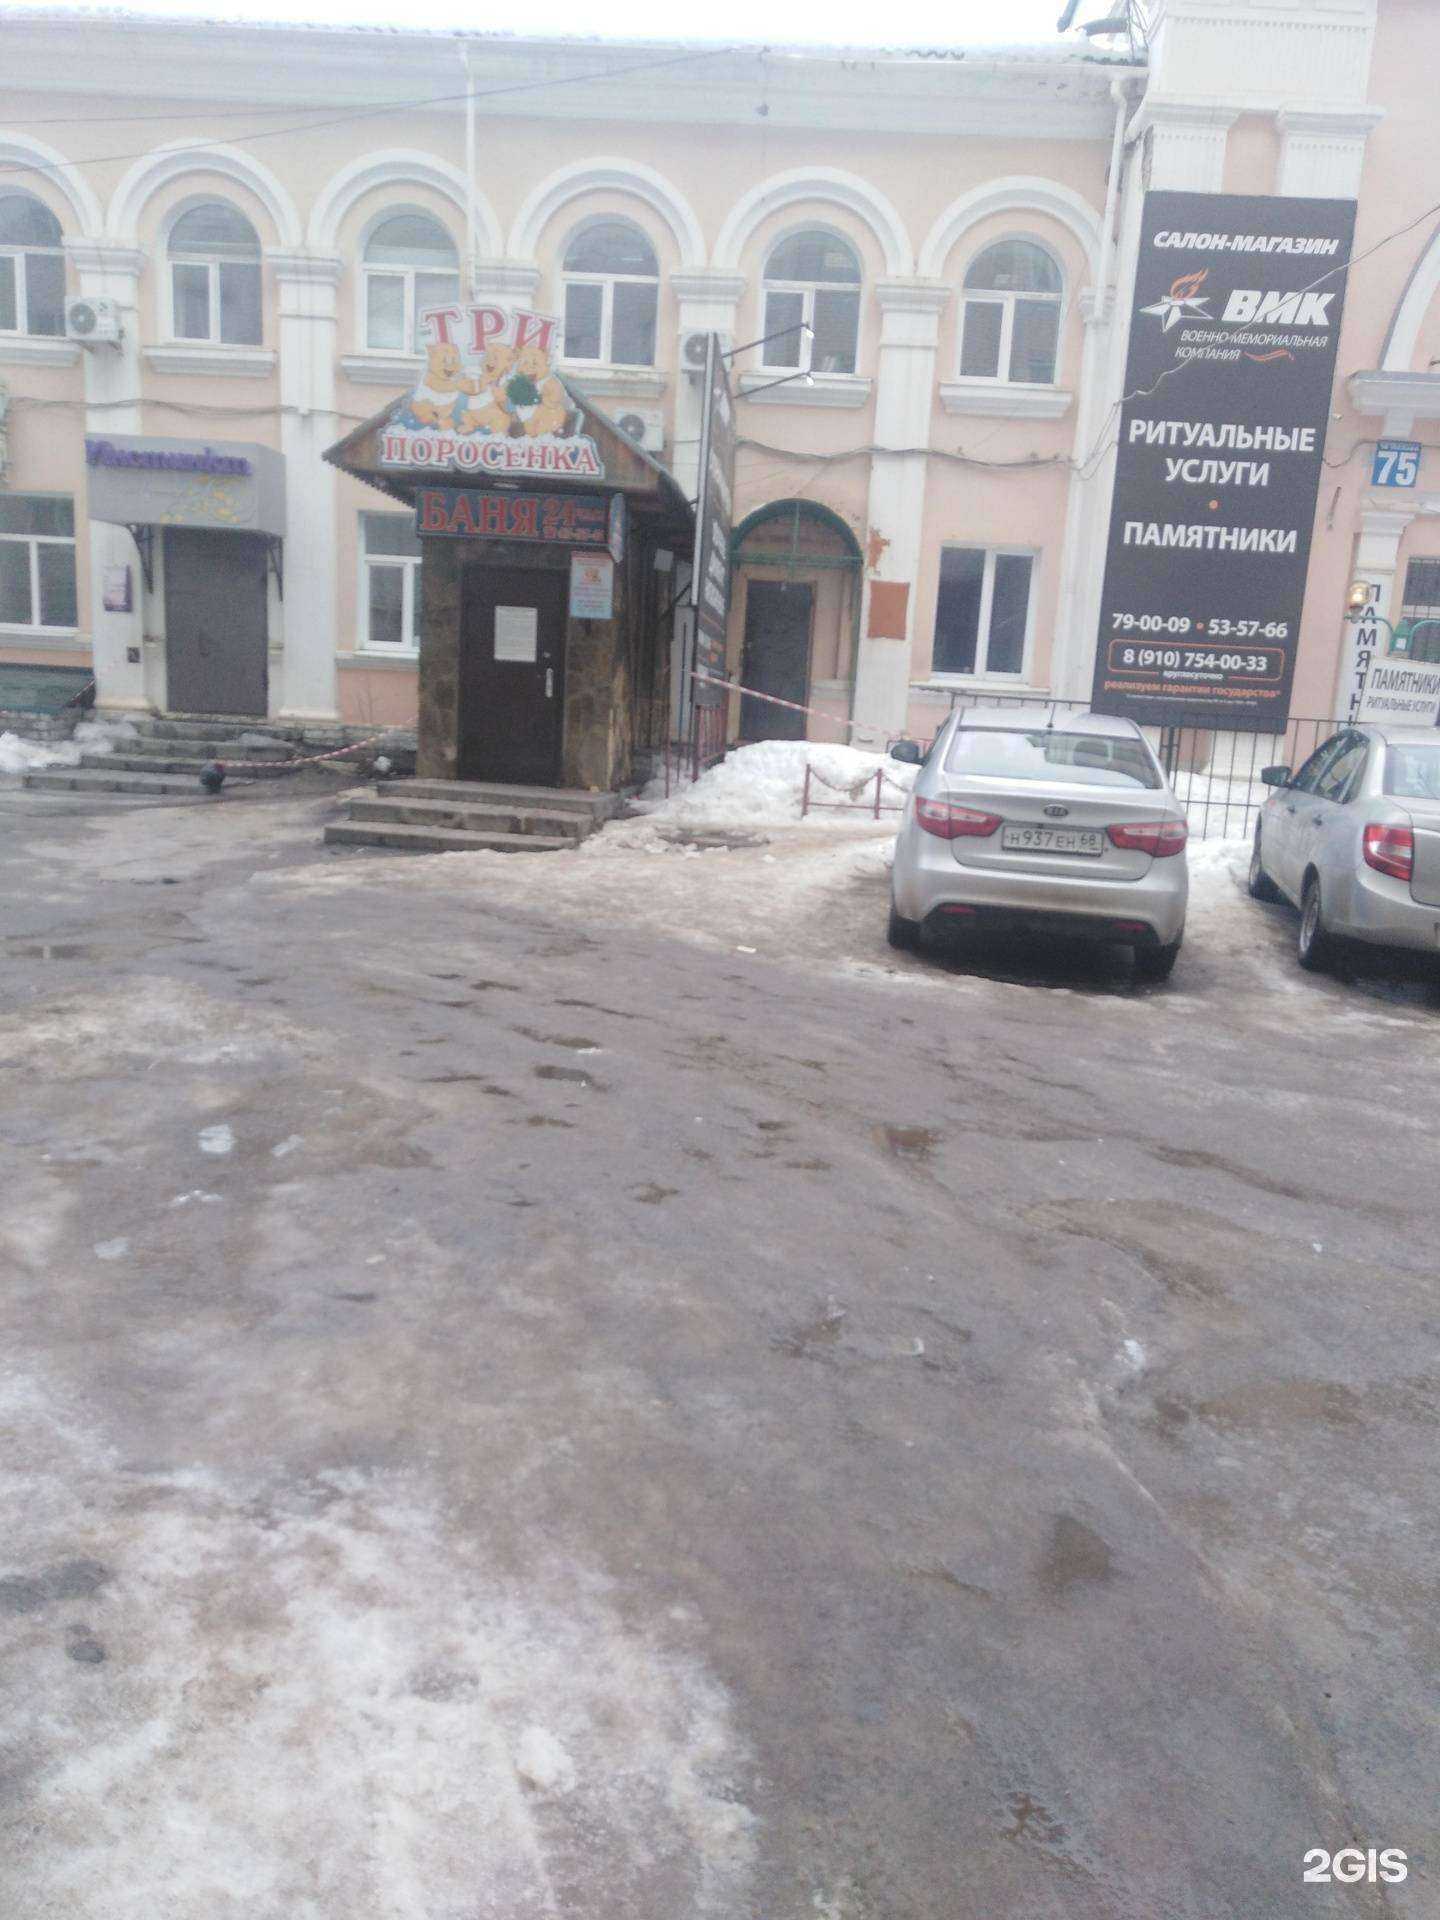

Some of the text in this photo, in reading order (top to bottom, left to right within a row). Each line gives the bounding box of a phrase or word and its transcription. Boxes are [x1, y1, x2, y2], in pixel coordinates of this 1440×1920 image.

[1153, 231, 1339, 255] САЛОН-МАГАЗИН
[1221, 289, 1336, 325] ВМК
[424, 307, 556, 356] ТРИ
[1180, 329, 1329, 348] ВОЕННО-МЕМОРИАЛЬНАЯ
[1174, 346, 1242, 360] КОМПАНИЯ
[1128, 419, 1316, 452] РИТУАЛЬНЫЕ
[383, 435, 599, 473] ПОРОСЕНКА
[1376, 451, 1417, 486] 75
[1165, 458, 1270, 487] УСЛУГИ
[421, 491, 539, 538] БАНЯ
[1123, 521, 1298, 553] ПАМЯТНИКИ
[1111, 613, 1288, 638] 79-00-09 53-57-66
[1123, 648, 1268, 672] 8 (910) 754-00-33
